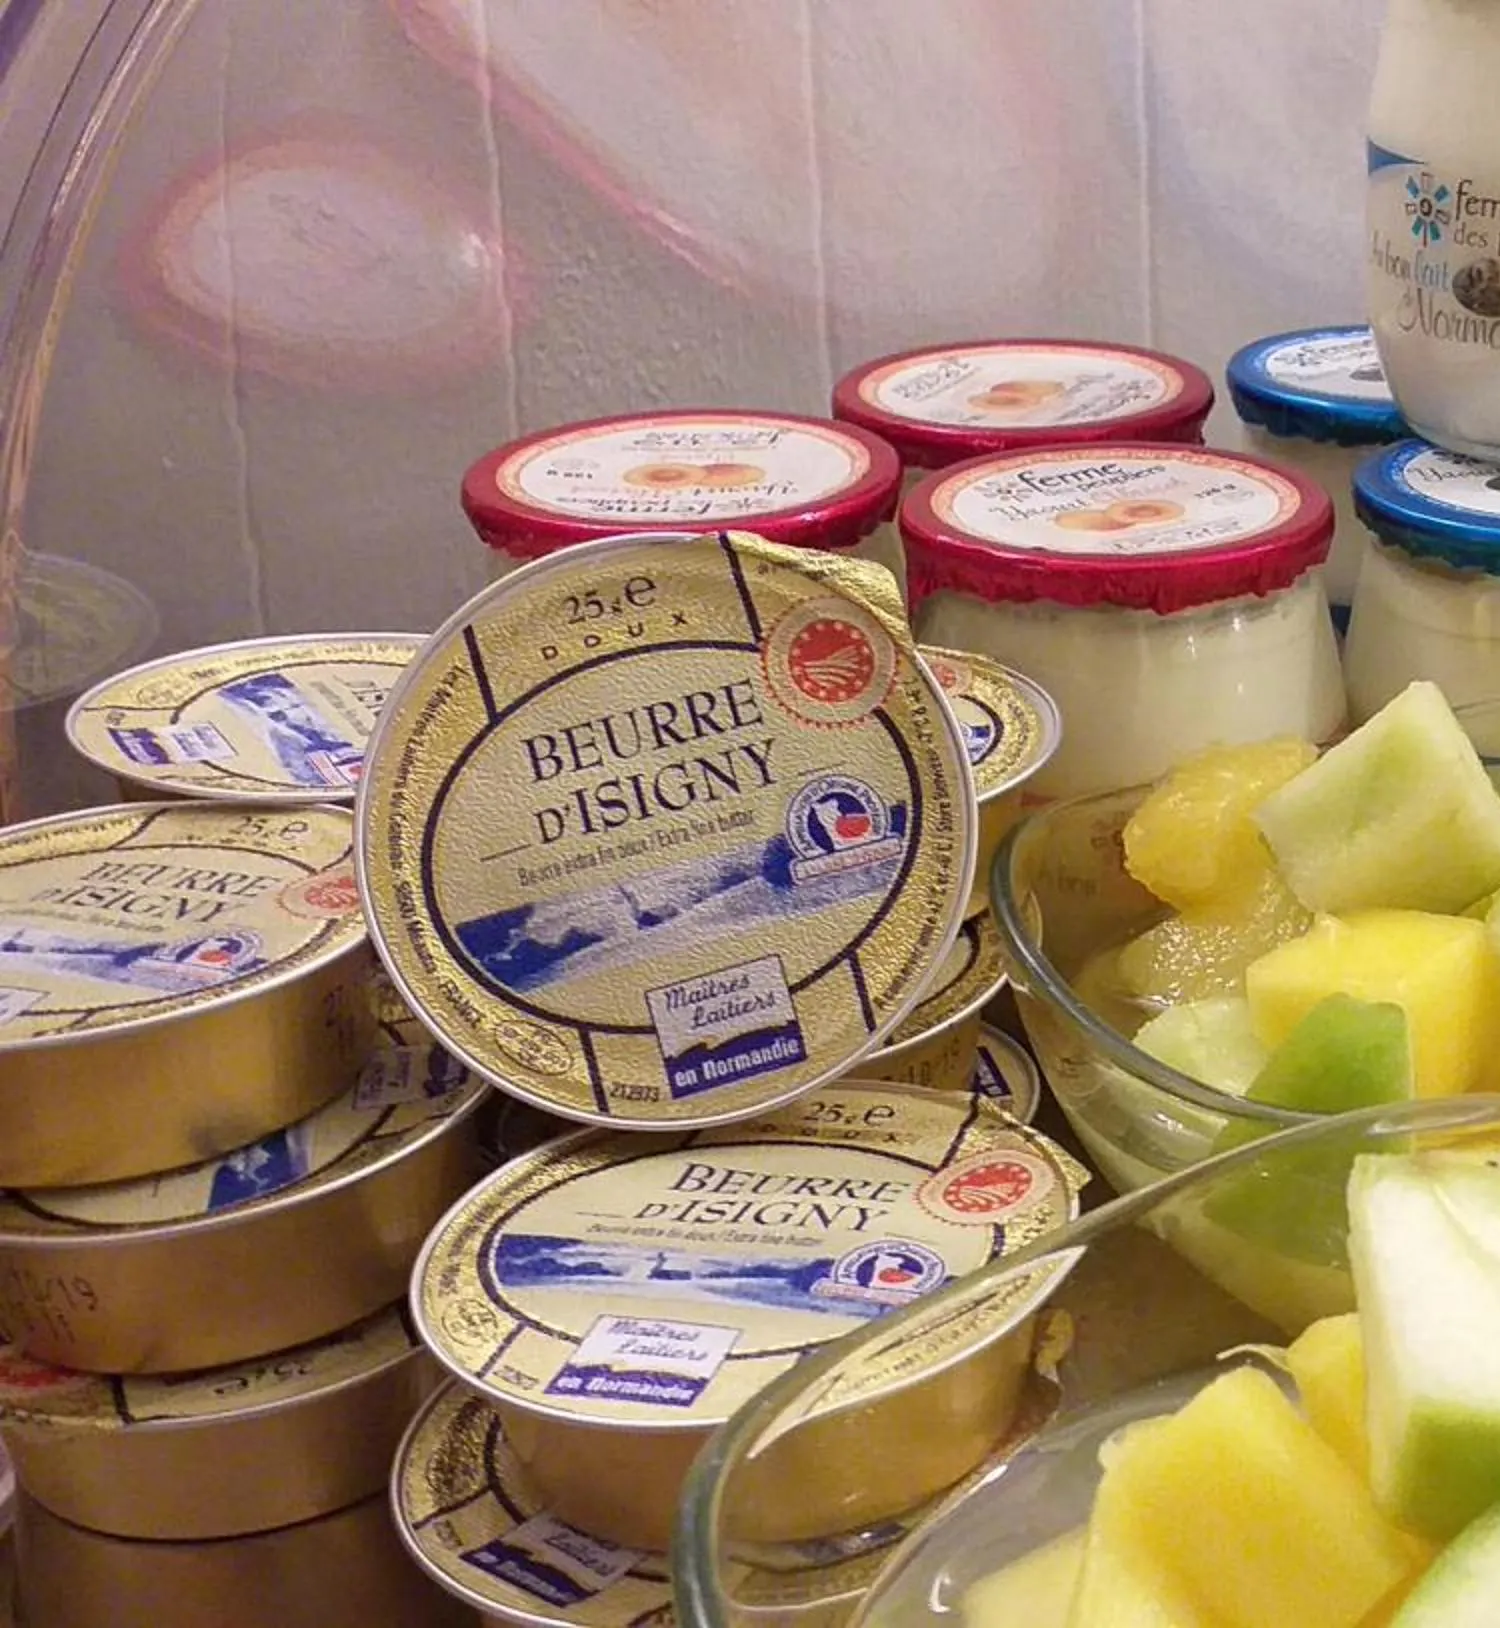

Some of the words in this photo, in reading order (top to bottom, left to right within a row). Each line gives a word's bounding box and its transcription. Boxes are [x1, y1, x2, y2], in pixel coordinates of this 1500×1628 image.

[1453, 222, 1489, 247] des
[1414, 250, 1449, 292] lait
[1018, 463, 1124, 493] ferme
[1077, 465, 1167, 493] peupliers
[541, 613, 688, 661] DOUX
[520, 678, 764, 783] BEURRE
[533, 738, 777, 844] D'ISIGNY
[80, 862, 284, 897] BEURRE
[664, 973, 751, 1010] Maîtres
[690, 989, 777, 1031] Laitiers
[674, 1067, 699, 1088] en
[702, 1035, 801, 1080] Normandie
[667, 1163, 912, 1203] BEURRE
[634, 1199, 889, 1231] D'ISIGNY
[613, 1339, 709, 1361] Laitiers
[586, 1377, 696, 1401] Normandie
